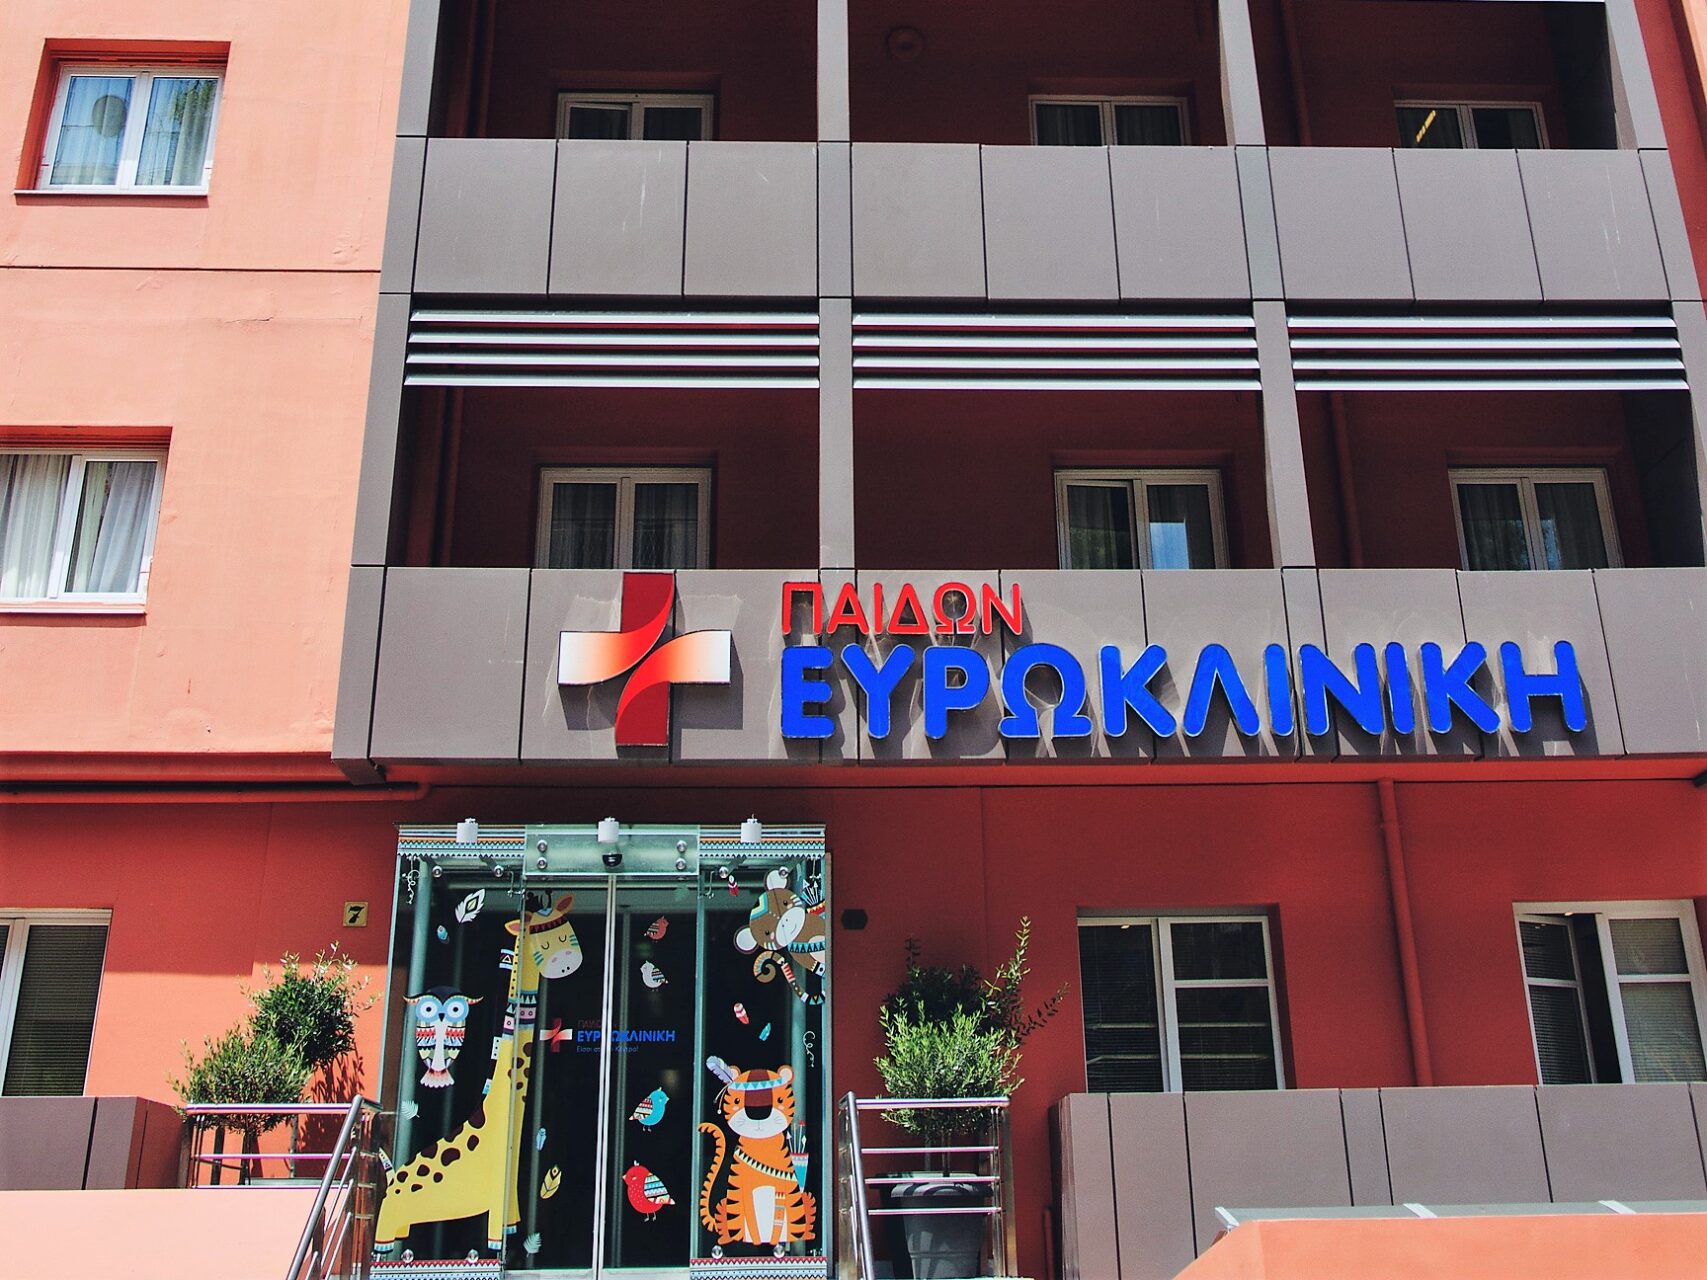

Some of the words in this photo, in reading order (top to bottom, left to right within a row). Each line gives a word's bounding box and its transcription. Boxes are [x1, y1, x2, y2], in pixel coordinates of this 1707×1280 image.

[781, 581, 1023, 636] ΠΑΙΔΩΝ
[780, 640, 1588, 740] ΕΥΡΩΚΛΙΝΙΚΗ
[347, 905, 365, 924] 7
